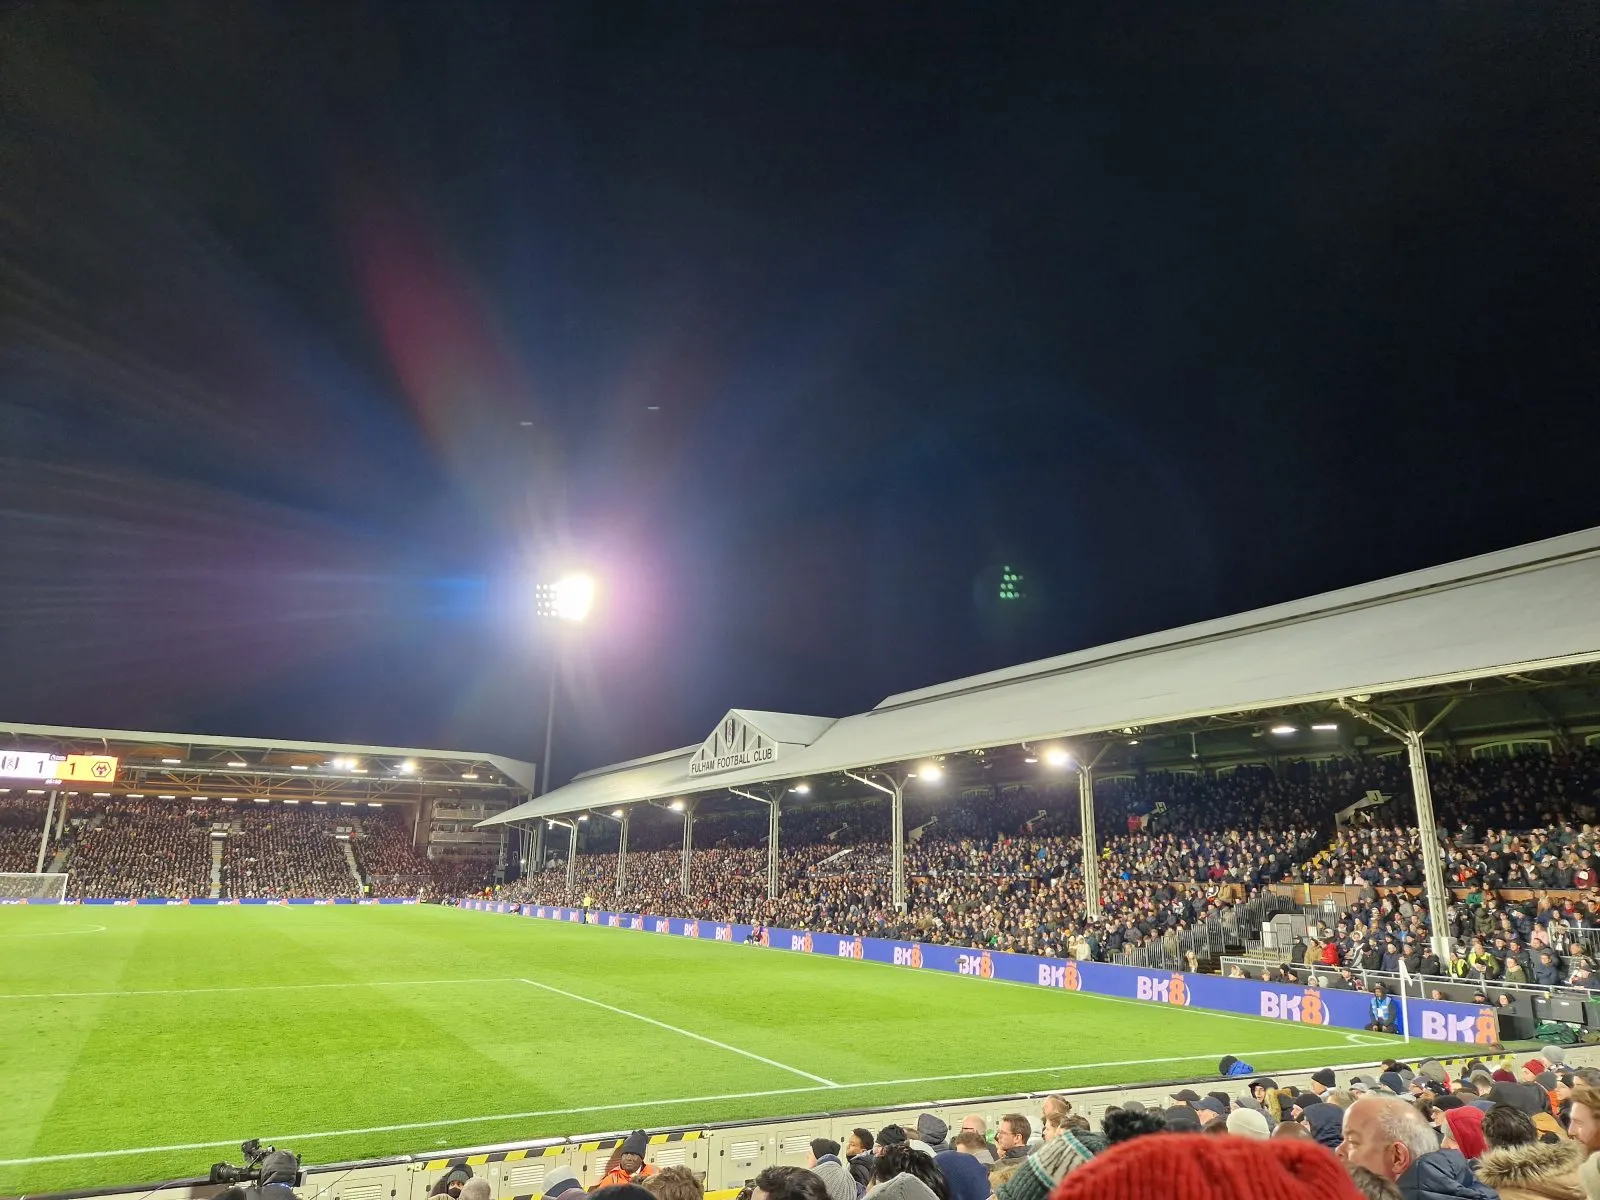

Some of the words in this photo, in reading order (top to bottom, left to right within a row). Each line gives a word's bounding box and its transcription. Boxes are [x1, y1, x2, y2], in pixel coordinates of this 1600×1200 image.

[37, 760, 44, 774] 1
[69, 762, 76, 775] 1
[691, 760, 715, 773] FULHAM
[717, 753, 751, 768] FOOTBALL
[753, 748, 773, 762] CLUB
[1372, 792, 1379, 802] J
[791, 934, 812, 954] BK8
[839, 940, 862, 960] BK8
[893, 946, 922, 968] BK8
[1038, 963, 1078, 991] BK8
[1137, 975, 1186, 1006] BK8
[1260, 990, 1323, 1025] BK8
[1422, 1010, 1498, 1044] BK8
